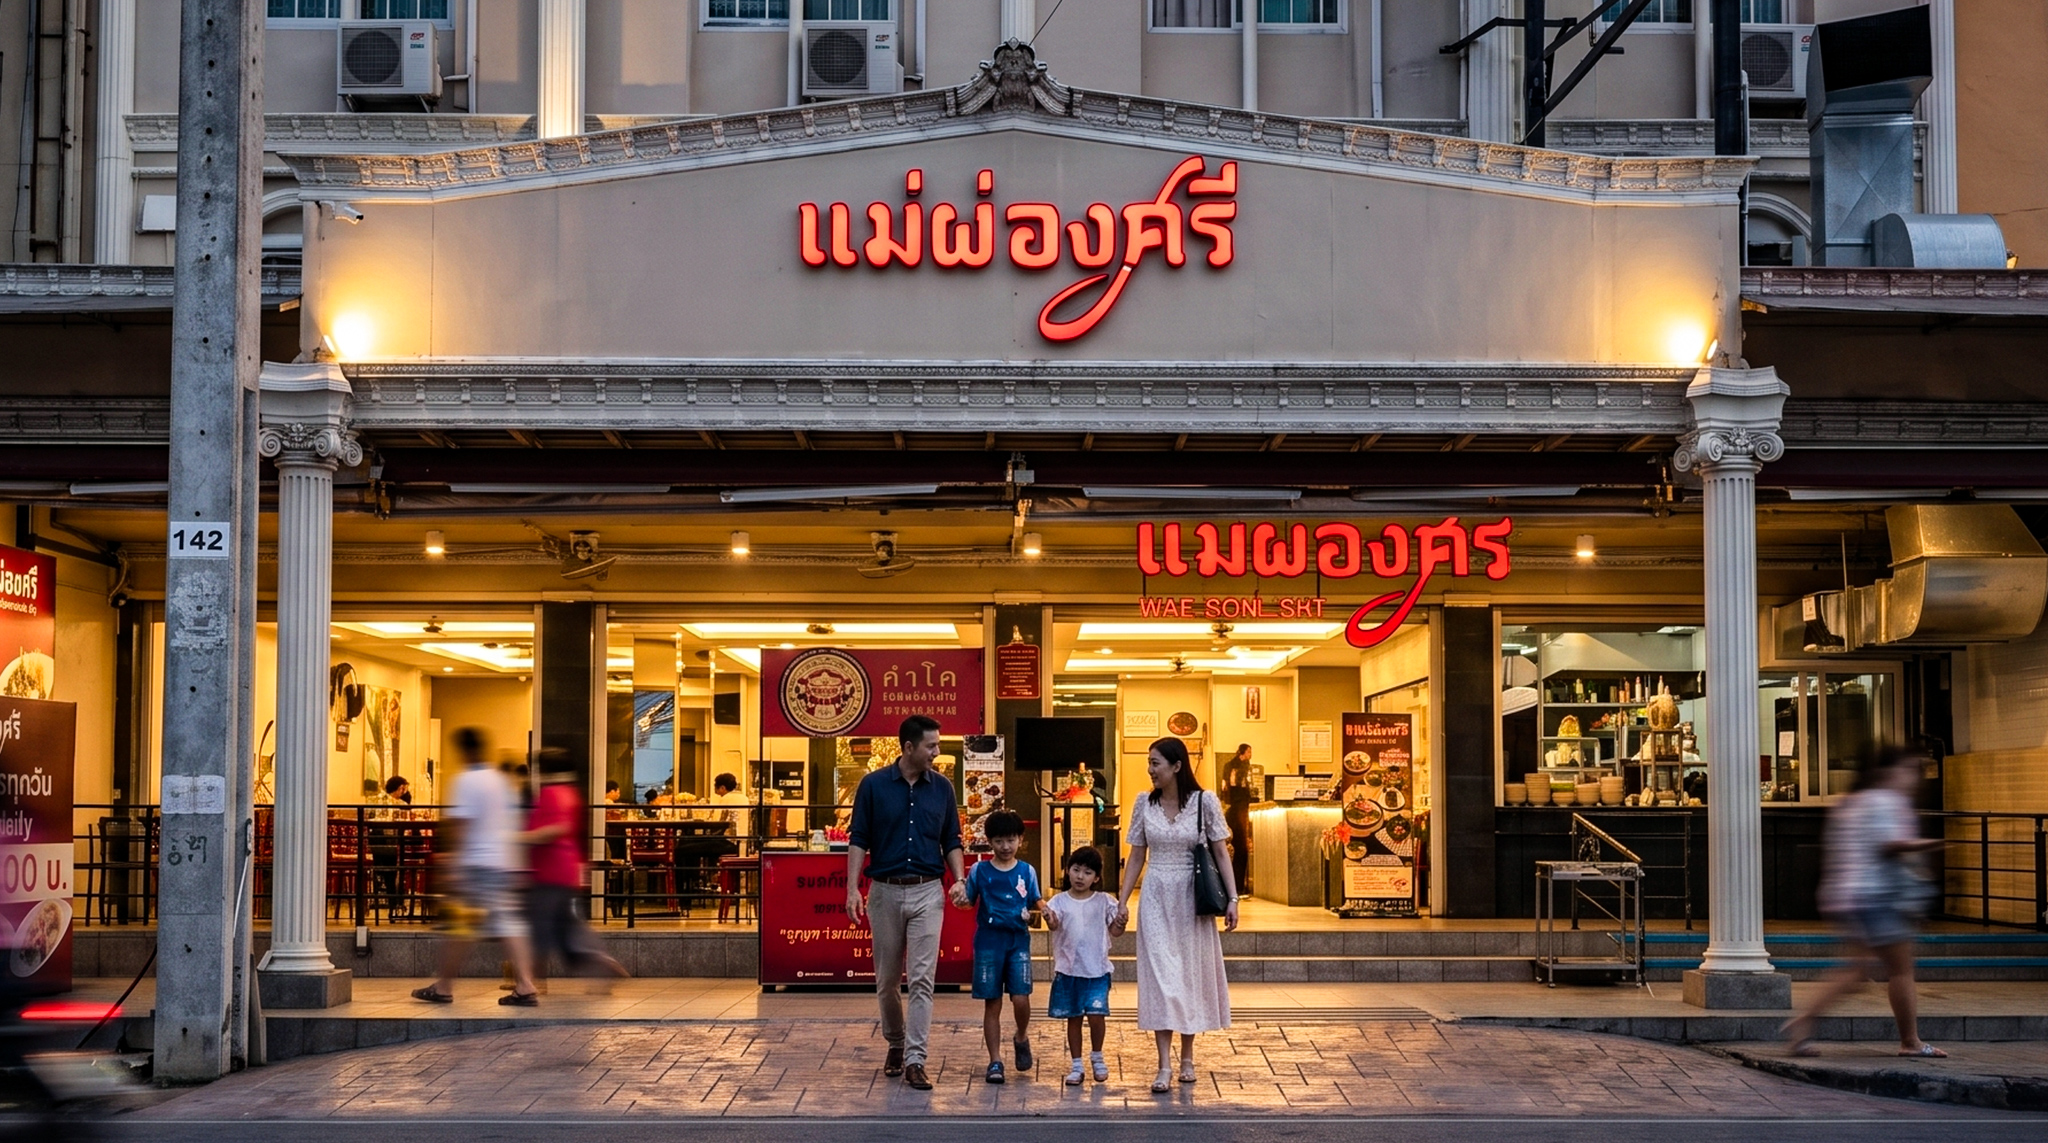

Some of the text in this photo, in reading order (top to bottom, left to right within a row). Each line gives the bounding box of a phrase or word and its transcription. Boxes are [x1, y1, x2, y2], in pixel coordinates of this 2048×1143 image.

[799, 156, 1238, 342] แม่ผ่องศรี
[173, 529, 223, 551] 142
[1139, 598, 1194, 618] WAE
